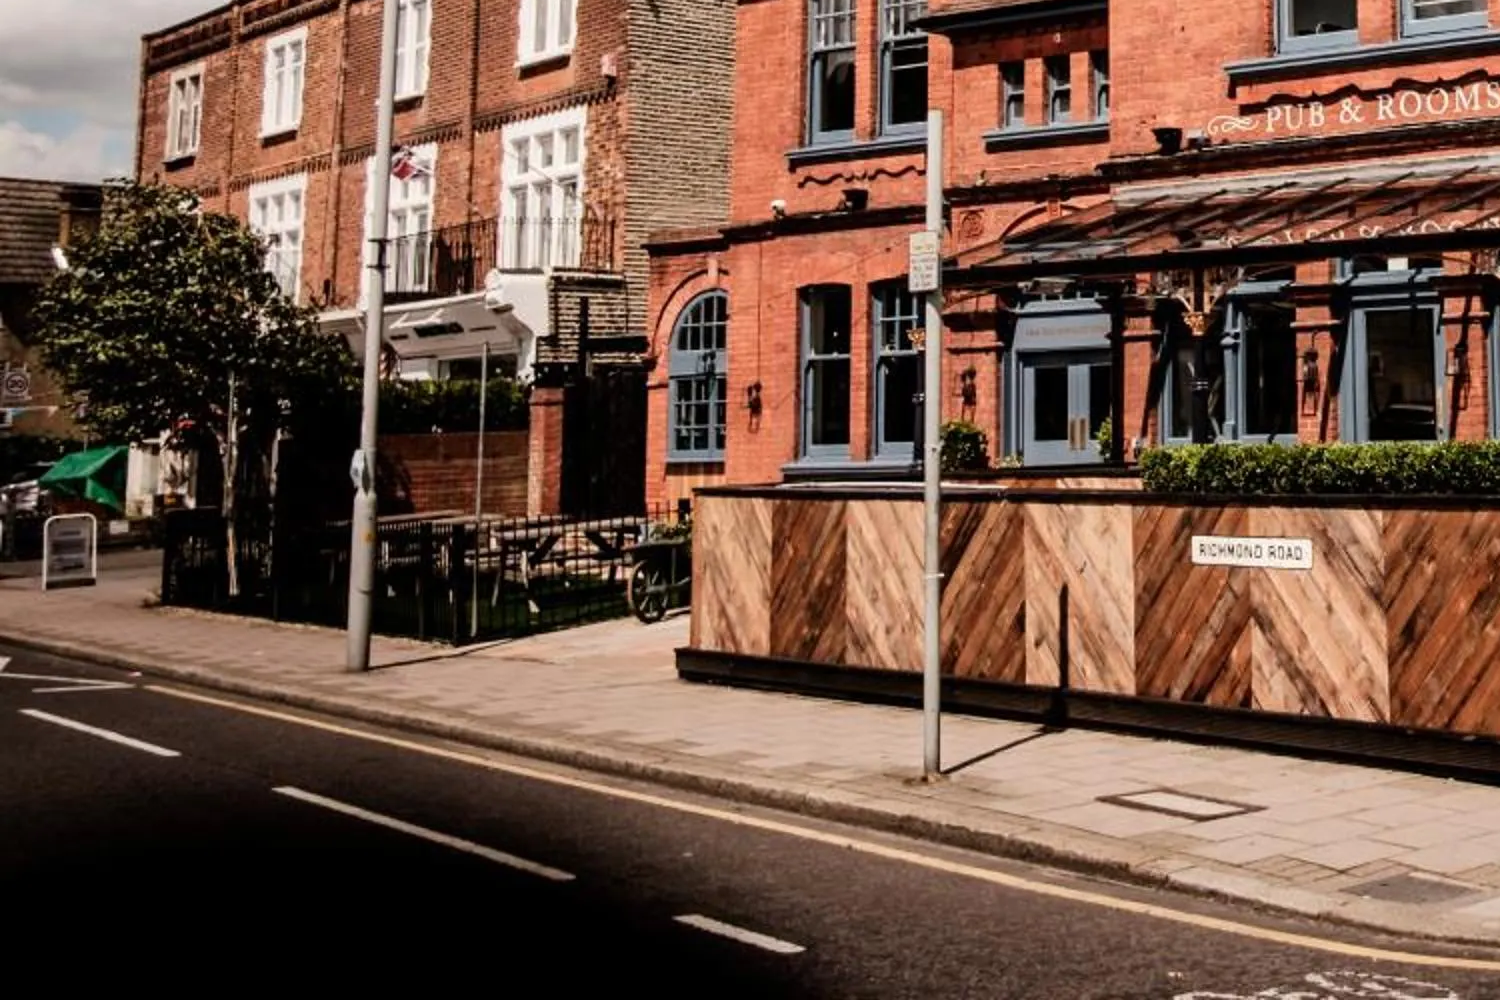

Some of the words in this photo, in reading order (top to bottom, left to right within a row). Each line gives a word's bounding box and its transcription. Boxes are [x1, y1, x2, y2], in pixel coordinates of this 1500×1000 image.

[1265, 101, 1325, 132] PUB
[1339, 97, 1364, 124] &
[1199, 543, 1263, 559] RICHMOND
[1267, 545, 1303, 561] ROAD
